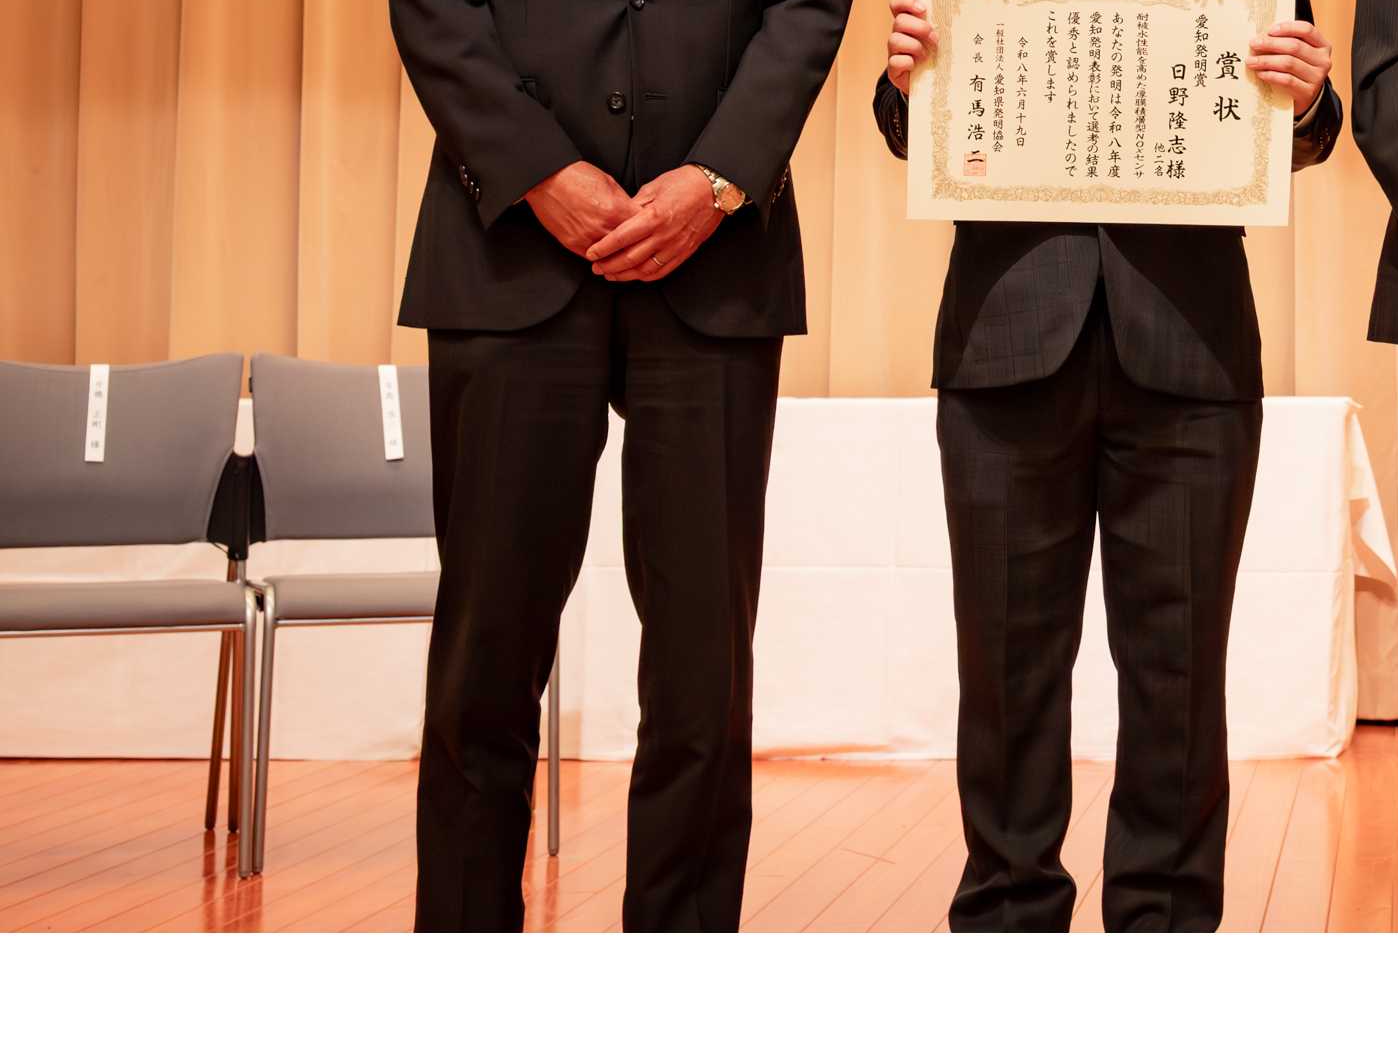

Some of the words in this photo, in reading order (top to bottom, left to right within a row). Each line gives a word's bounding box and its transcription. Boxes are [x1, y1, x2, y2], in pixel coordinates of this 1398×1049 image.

[1015, 35, 1029, 148] 令和八年六月十九日
[1043, 10, 1059, 104] これを賞します
[1064, 11, 1081, 177] 優秀と認められましたので
[1085, 11, 1103, 179] 愛知発明表彰において選考の結果
[1107, 12, 1124, 179] あなたの発明は令和八年度
[1194, 14, 1209, 88] 愛知発明賞
[1213, 50, 1242, 123] 賞状
[1154, 142, 1166, 177] 他二名
[1166, 63, 1190, 180] 日野隆志様
